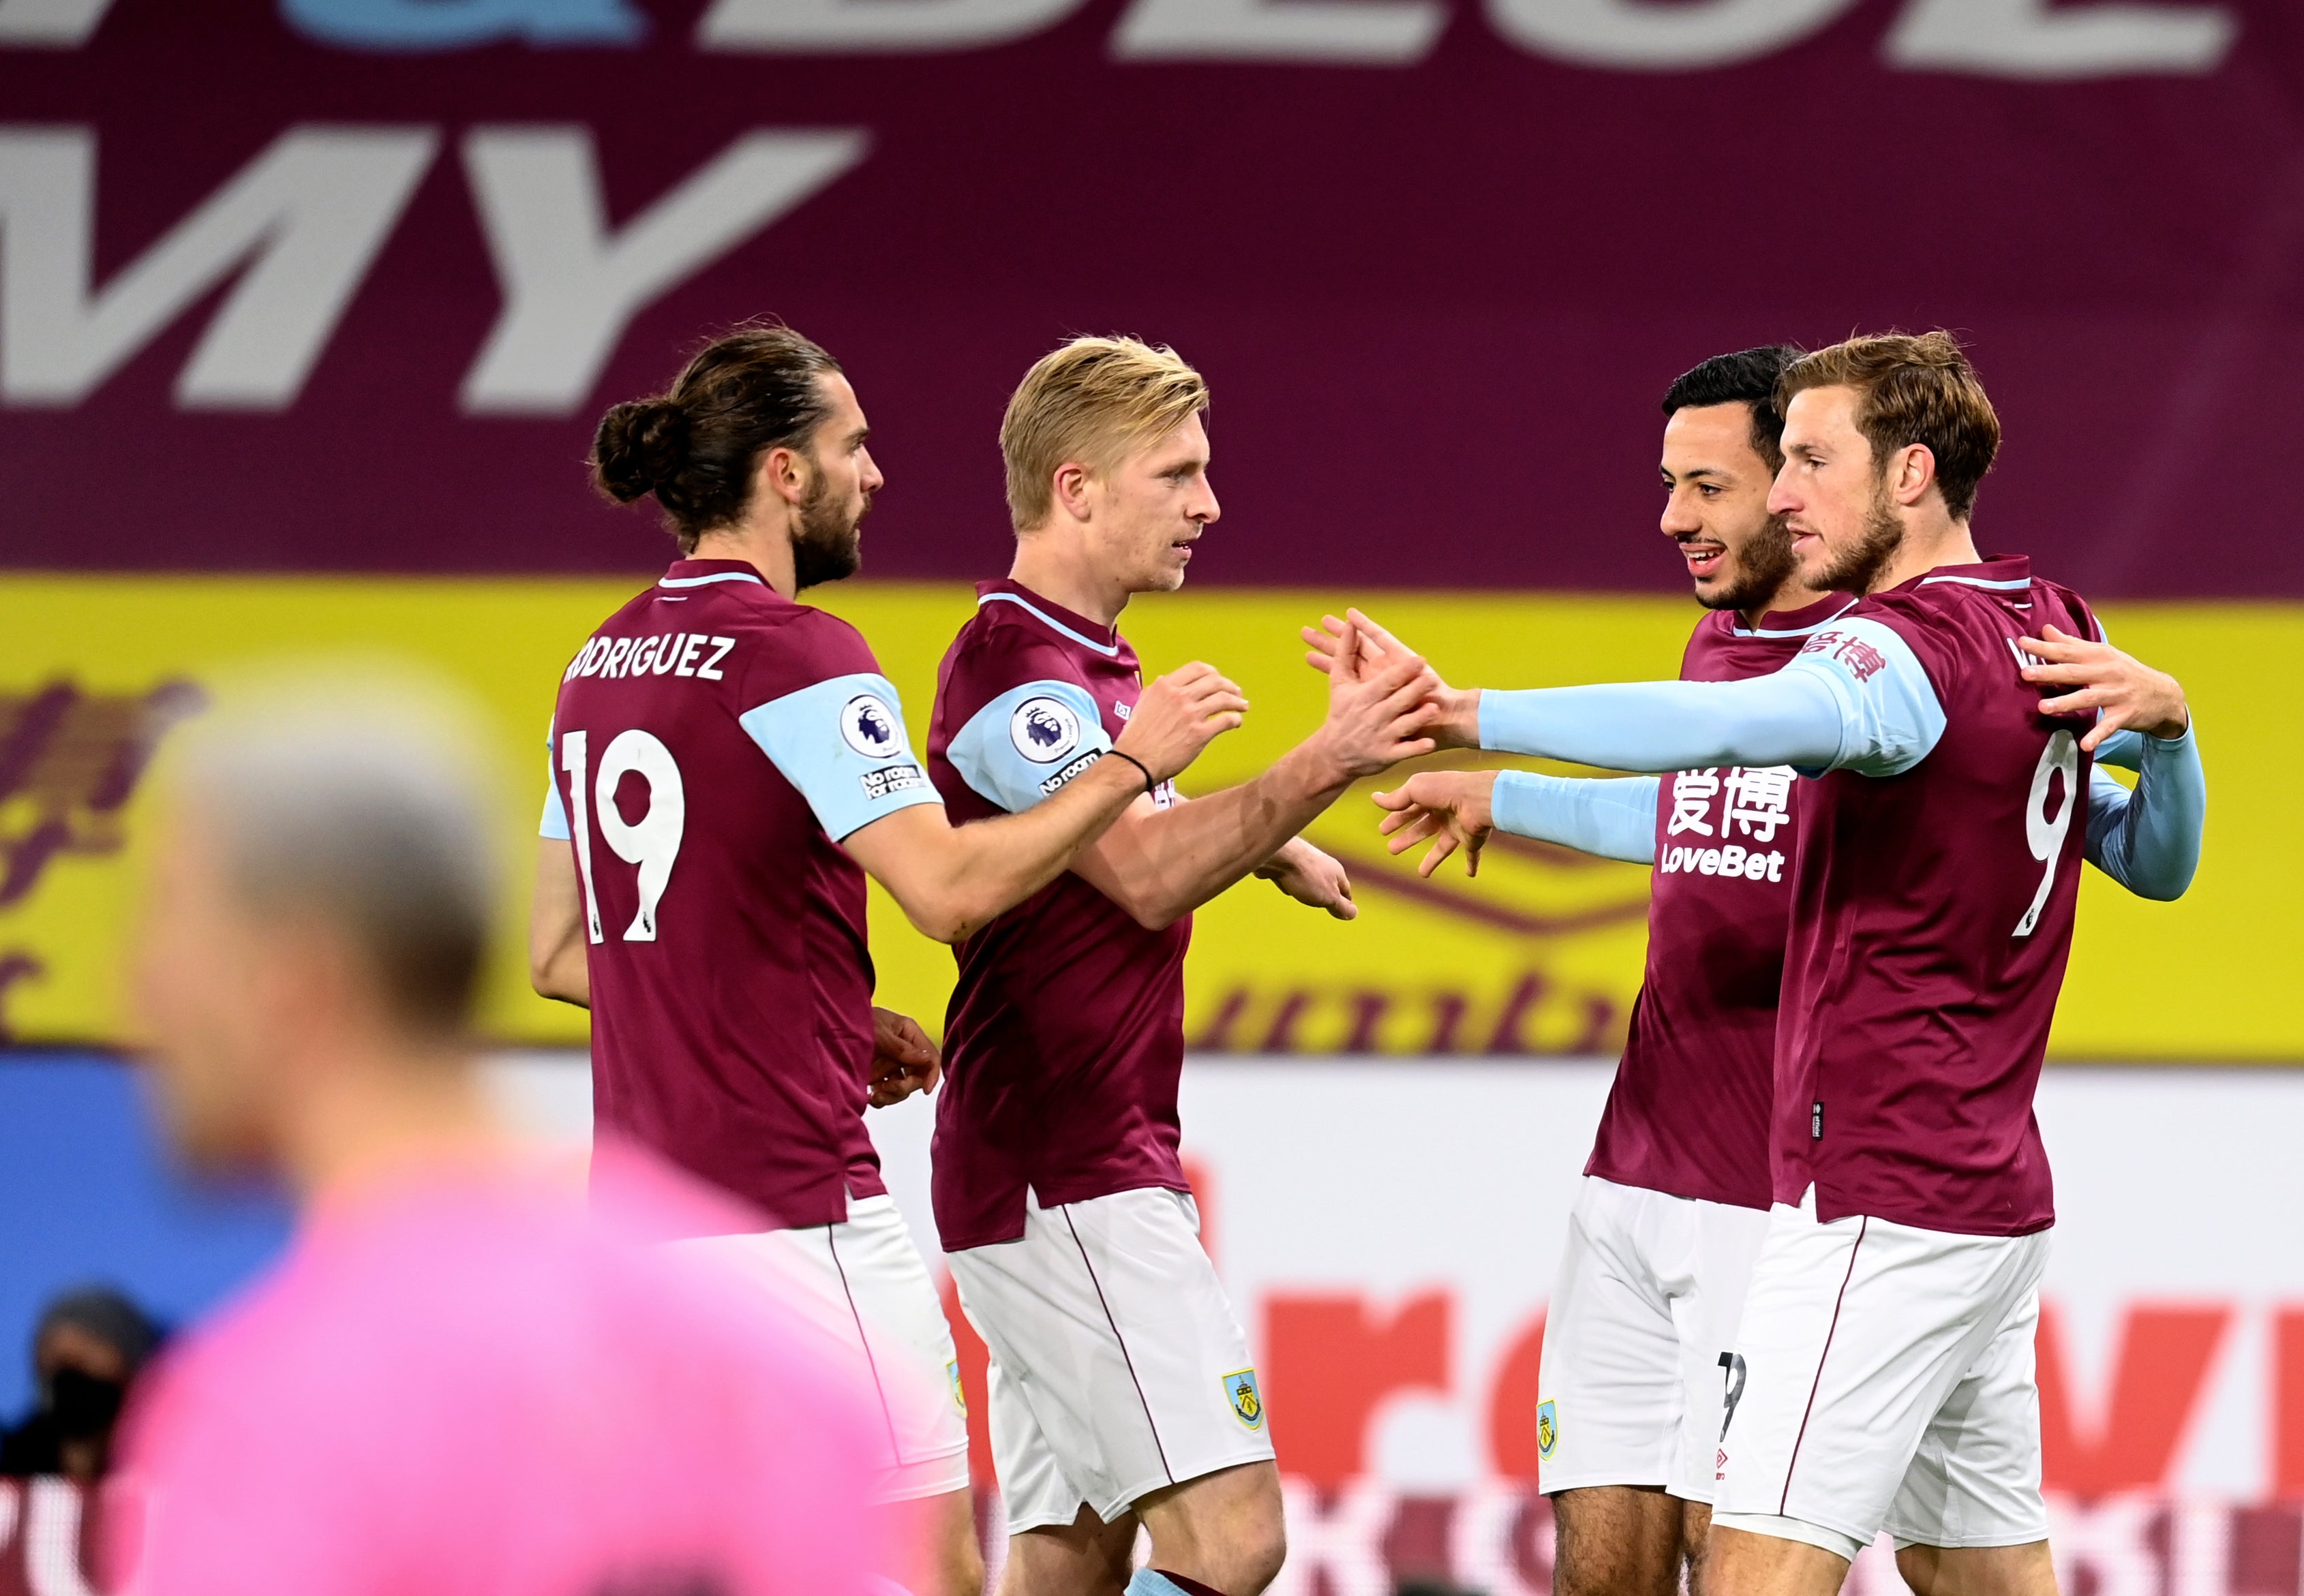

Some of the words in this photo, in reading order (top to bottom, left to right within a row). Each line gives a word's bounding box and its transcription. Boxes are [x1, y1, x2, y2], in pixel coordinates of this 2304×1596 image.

[859, 771, 885, 788] No
[1039, 776, 1062, 797] No
[1060, 753, 1099, 782] room
[562, 729, 685, 945] 19
[2012, 729, 2078, 937] 9
[1661, 842, 1785, 883] LoveBet
